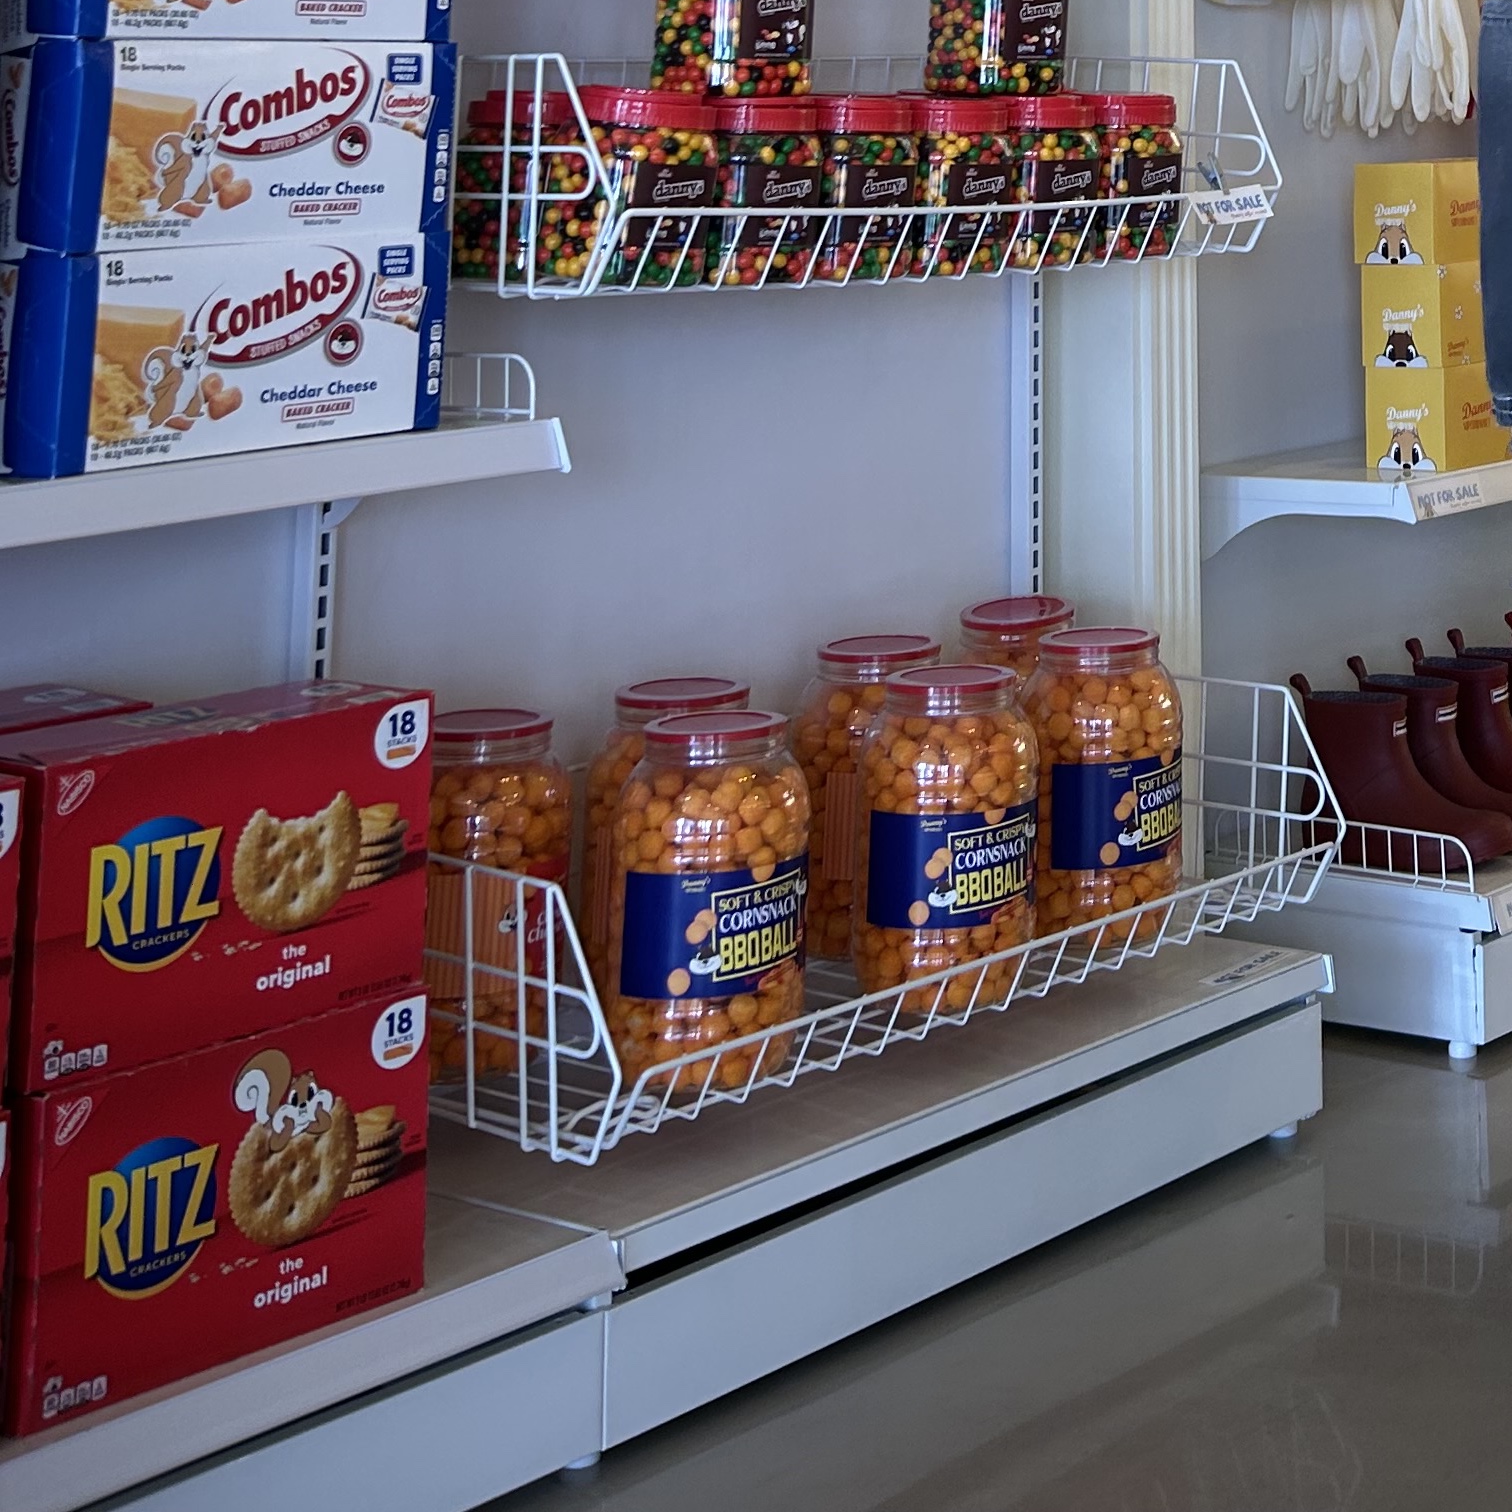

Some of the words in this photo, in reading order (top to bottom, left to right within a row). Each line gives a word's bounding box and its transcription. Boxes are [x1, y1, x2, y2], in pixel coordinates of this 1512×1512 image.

[120, 47, 138, 62] 18
[219, 63, 357, 135] Combos
[269, 182, 332, 197] Cheddar
[335, 181, 385, 196] Cheese
[1215, 199, 1235, 213] FOR
[1236, 193, 1263, 210] SALE
[1374, 200, 1416, 218] Danny's
[106, 260, 124, 276] 18
[209, 259, 349, 345] Combos
[1382, 304, 1424, 323] Danny's
[260, 386, 322, 404] Cheddar
[328, 379, 377, 395] Cheese
[1387, 403, 1429, 421] Danny's
[1436, 489, 1455, 504] FOR
[1456, 483, 1480, 499] SALE
[389, 710, 416, 737] 18
[387, 735, 417, 748] STACKS
[1138, 776, 1161, 793] SOFT
[954, 834, 984, 851] SOFT
[986, 831, 994, 844] &
[955, 836, 1027, 870] CORNSNACK
[86, 825, 224, 949] RITZ
[718, 892, 751, 913] SOFT
[753, 889, 762, 904] &
[720, 894, 797, 934] CORNSNACK
[132, 928, 190, 952] CRACKERS
[282, 943, 307, 960] the
[256, 954, 331, 991] original
[386, 1008, 413, 1037] 18
[384, 1033, 414, 1049] STACKS
[84, 1143, 220, 1280] RITZ
[129, 1250, 187, 1278] CRACKERS
[279, 1255, 304, 1273] the
[253, 1266, 328, 1308] original
